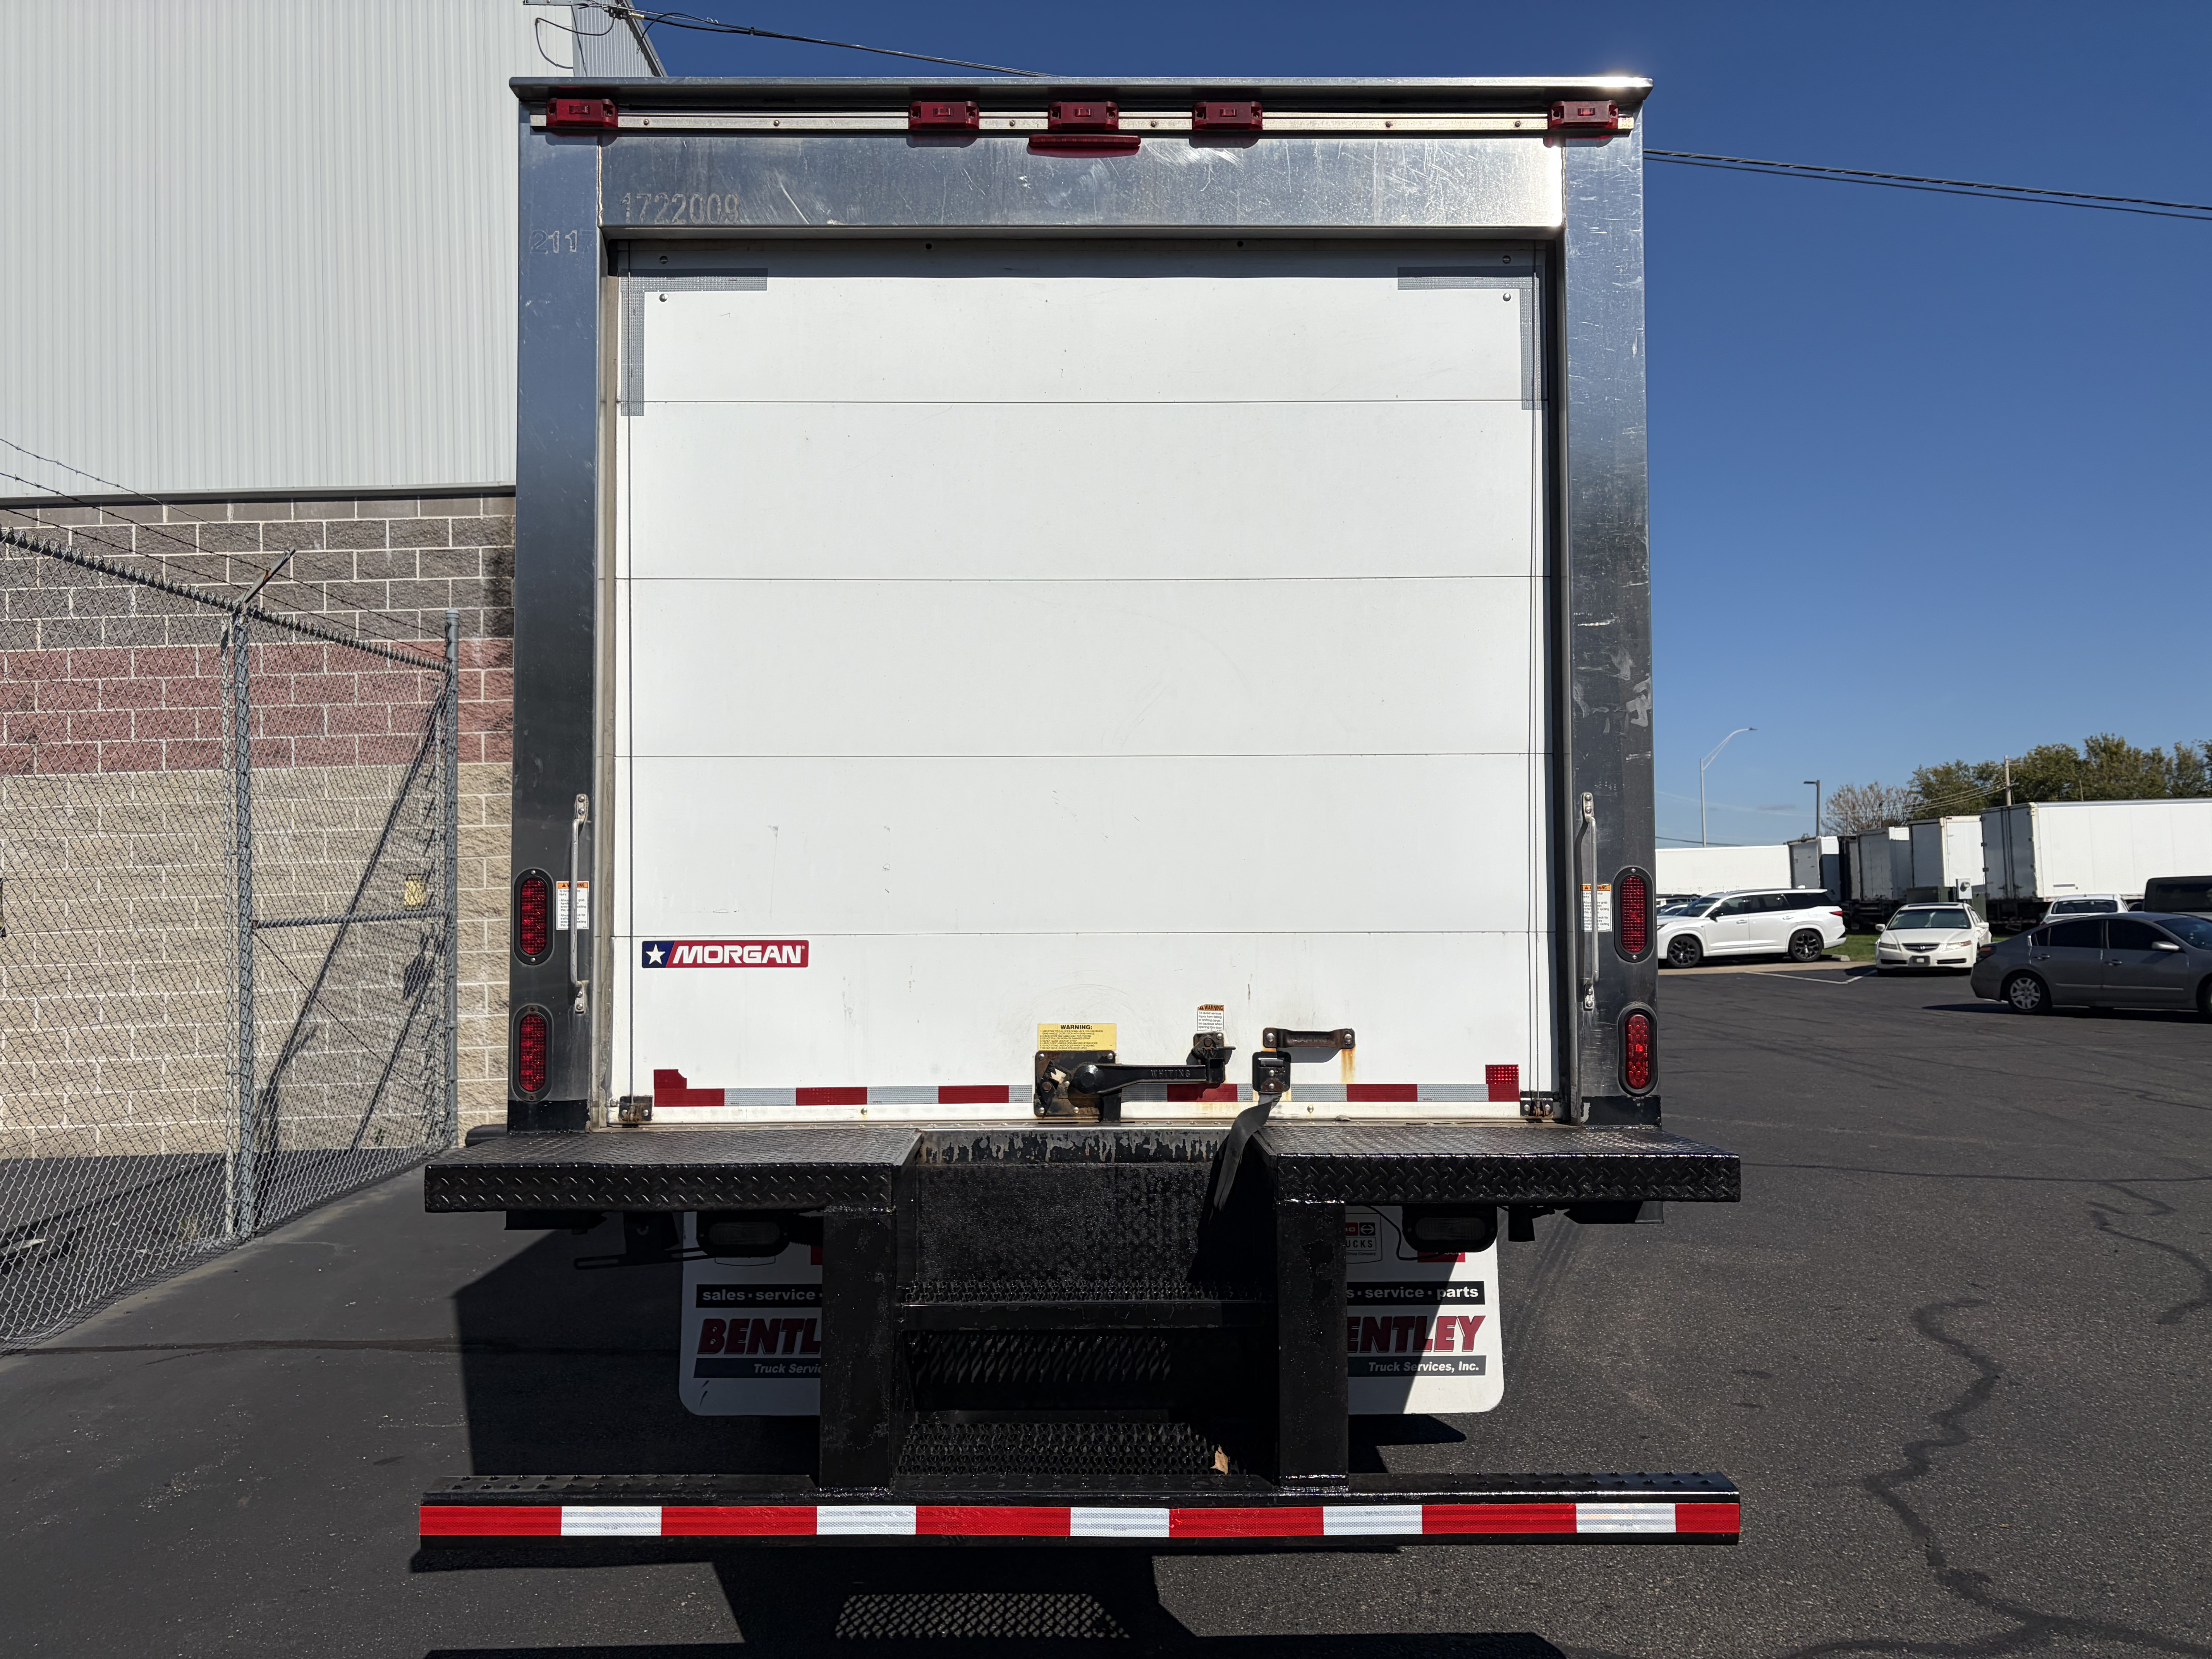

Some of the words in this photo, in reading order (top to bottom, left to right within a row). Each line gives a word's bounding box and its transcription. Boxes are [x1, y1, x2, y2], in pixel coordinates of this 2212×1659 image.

[672, 945, 801, 964] MORGAN
[1151, 1069, 1190, 1079] WHITING
[702, 1289, 745, 1301] sales
[756, 1289, 816, 1301] service
[1365, 1286, 1425, 1298] service
[1436, 1286, 1479, 1300] parts
[697, 1318, 821, 1354] BENTL
[1347, 1316, 1486, 1353] ENTLEY
[753, 1363, 787, 1374] Truck
[788, 1363, 821, 1374] Servic
[1368, 1362, 1401, 1372] Truck
[1403, 1362, 1455, 1373] Services,
[1458, 1361, 1479, 1371] Inc.
